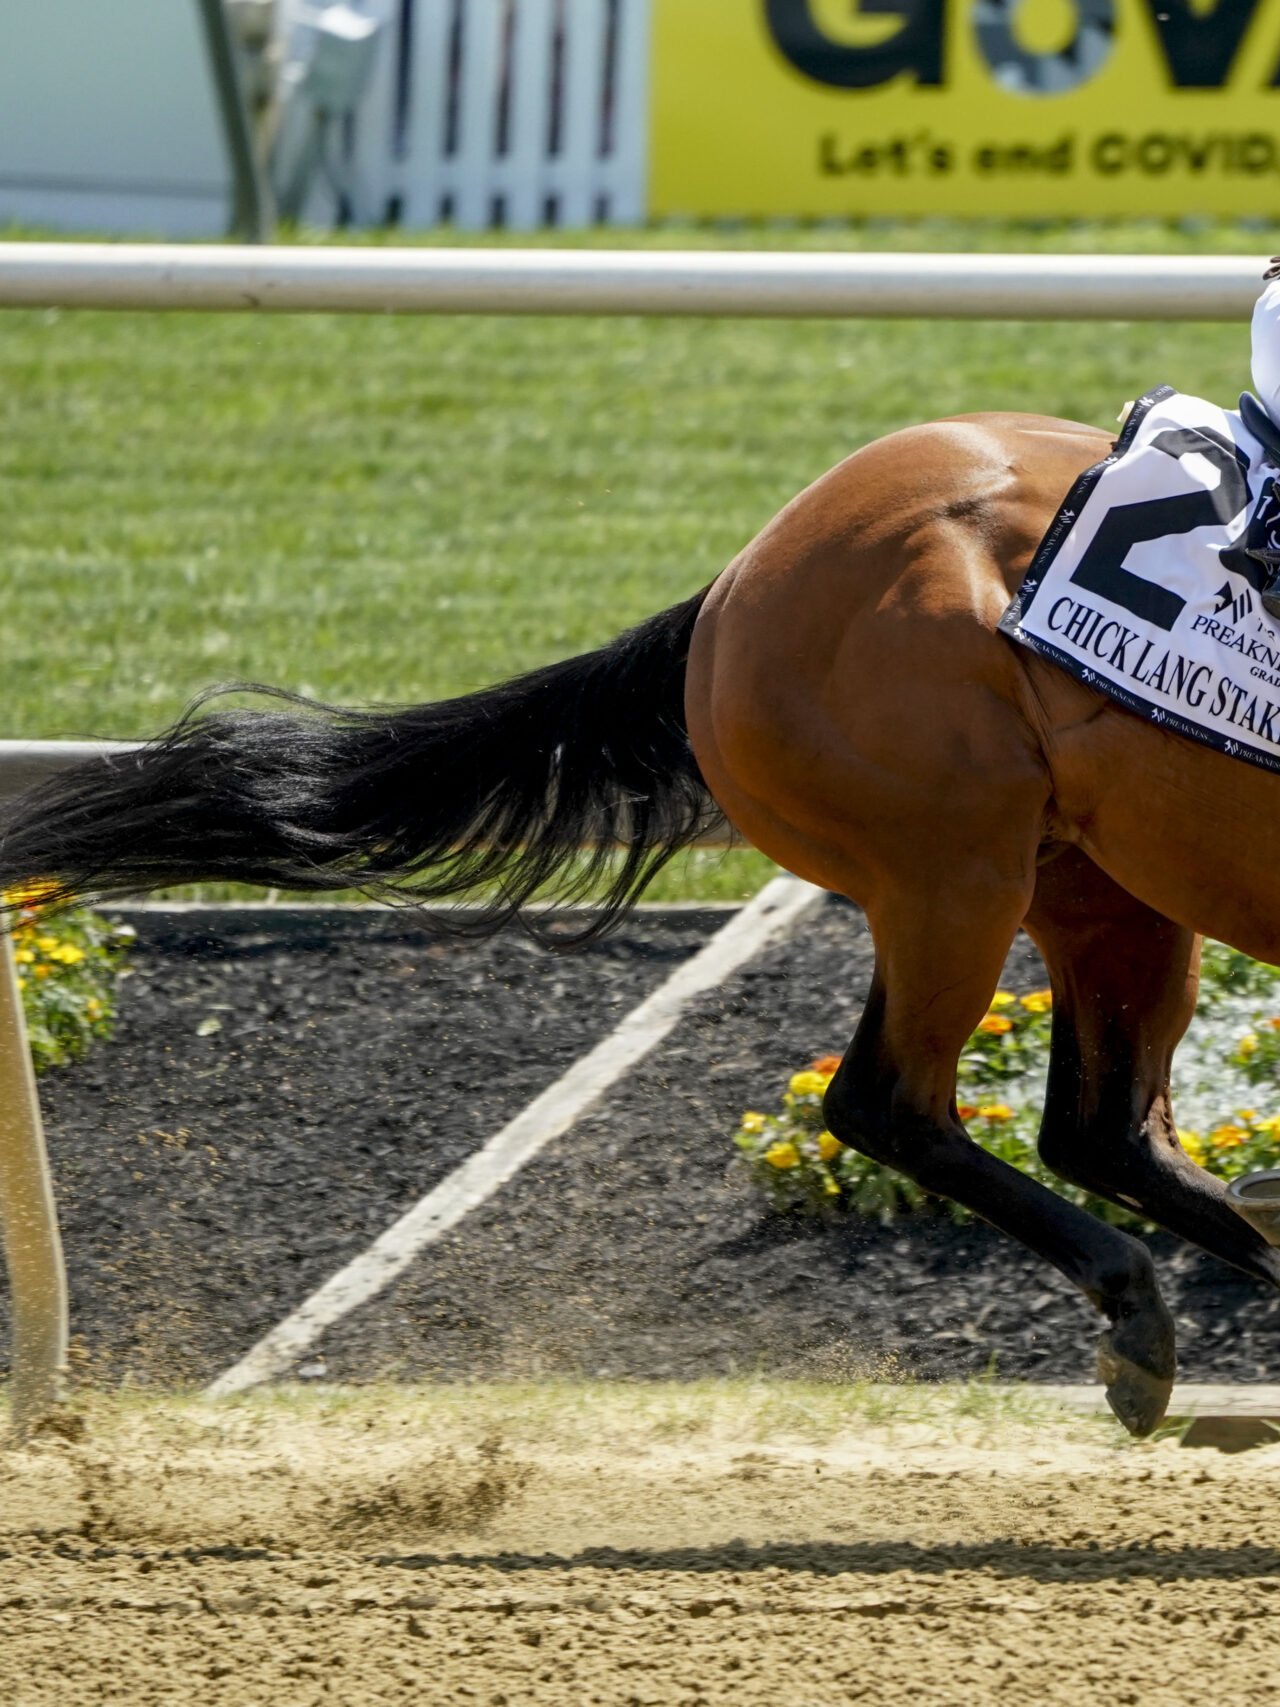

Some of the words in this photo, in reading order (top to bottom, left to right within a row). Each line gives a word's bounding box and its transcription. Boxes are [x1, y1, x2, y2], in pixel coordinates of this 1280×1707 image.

[818, 130, 953, 176] Let's
[972, 131, 1074, 176] end
[1069, 426, 1253, 632] 2
[1047, 596, 1140, 673] CHICK
[1129, 639, 1213, 707] LANG
